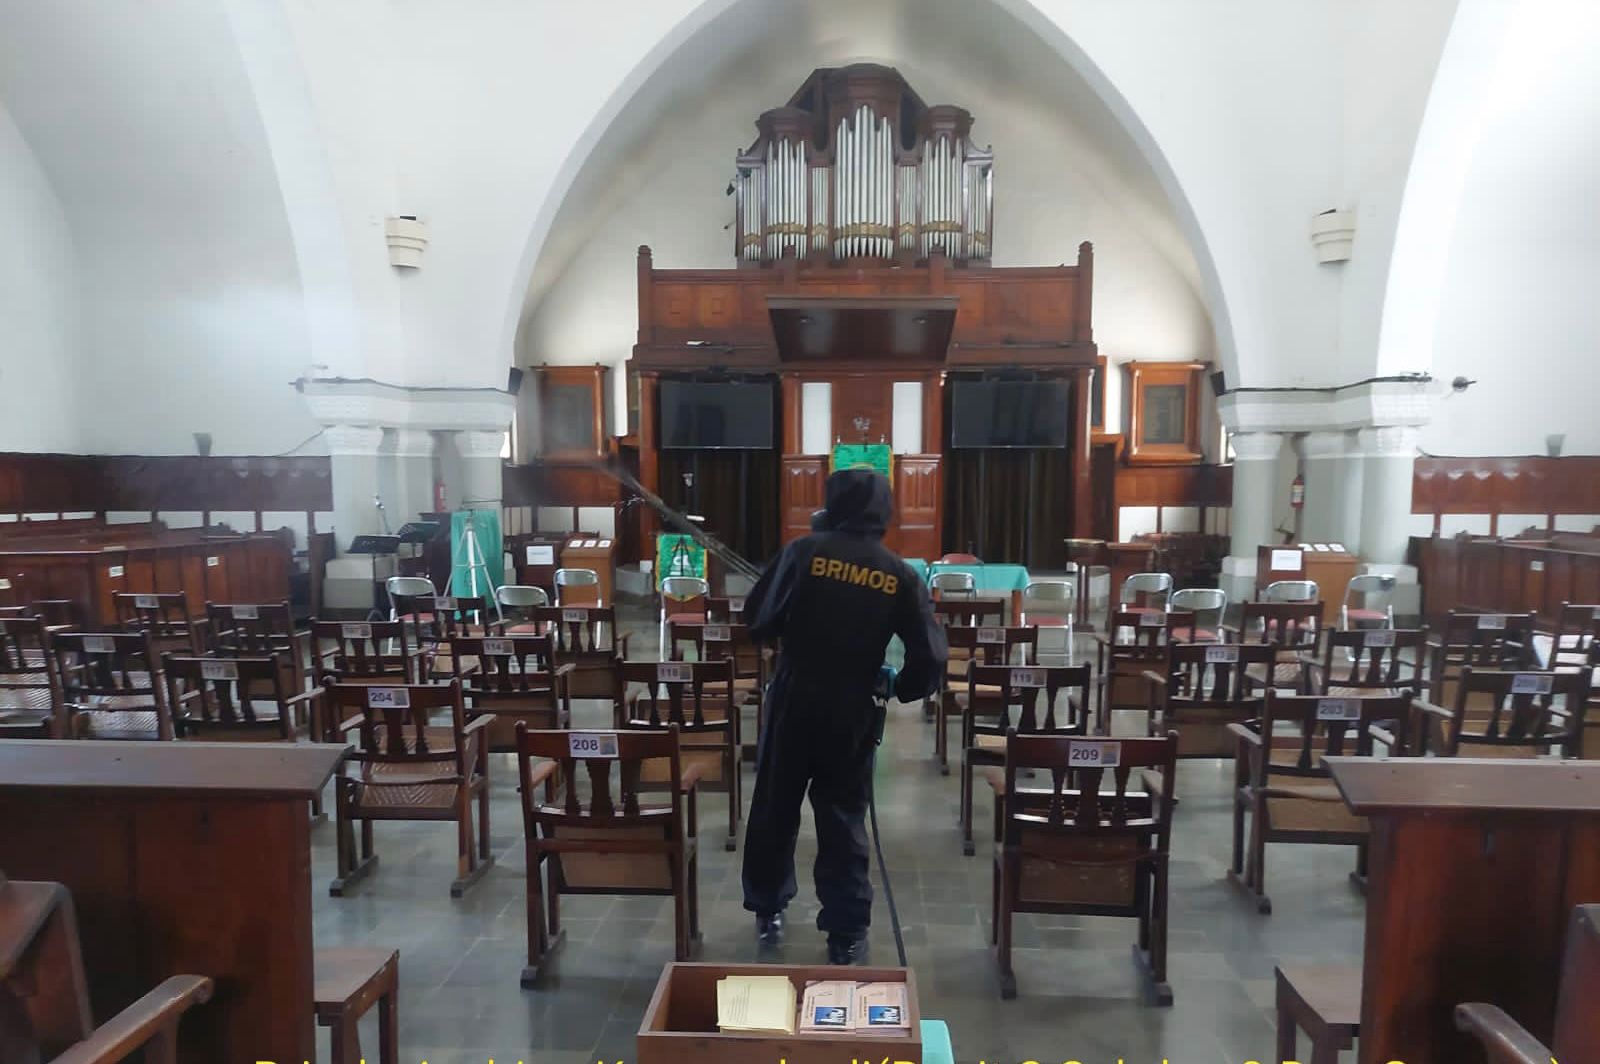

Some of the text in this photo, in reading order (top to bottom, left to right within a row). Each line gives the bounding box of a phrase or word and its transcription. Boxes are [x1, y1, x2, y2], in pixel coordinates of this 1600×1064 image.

[811, 557, 898, 595] BRIMOB
[370, 692, 393, 702] 204
[572, 739, 599, 751] 208
[1071, 748, 1099, 761] 209
